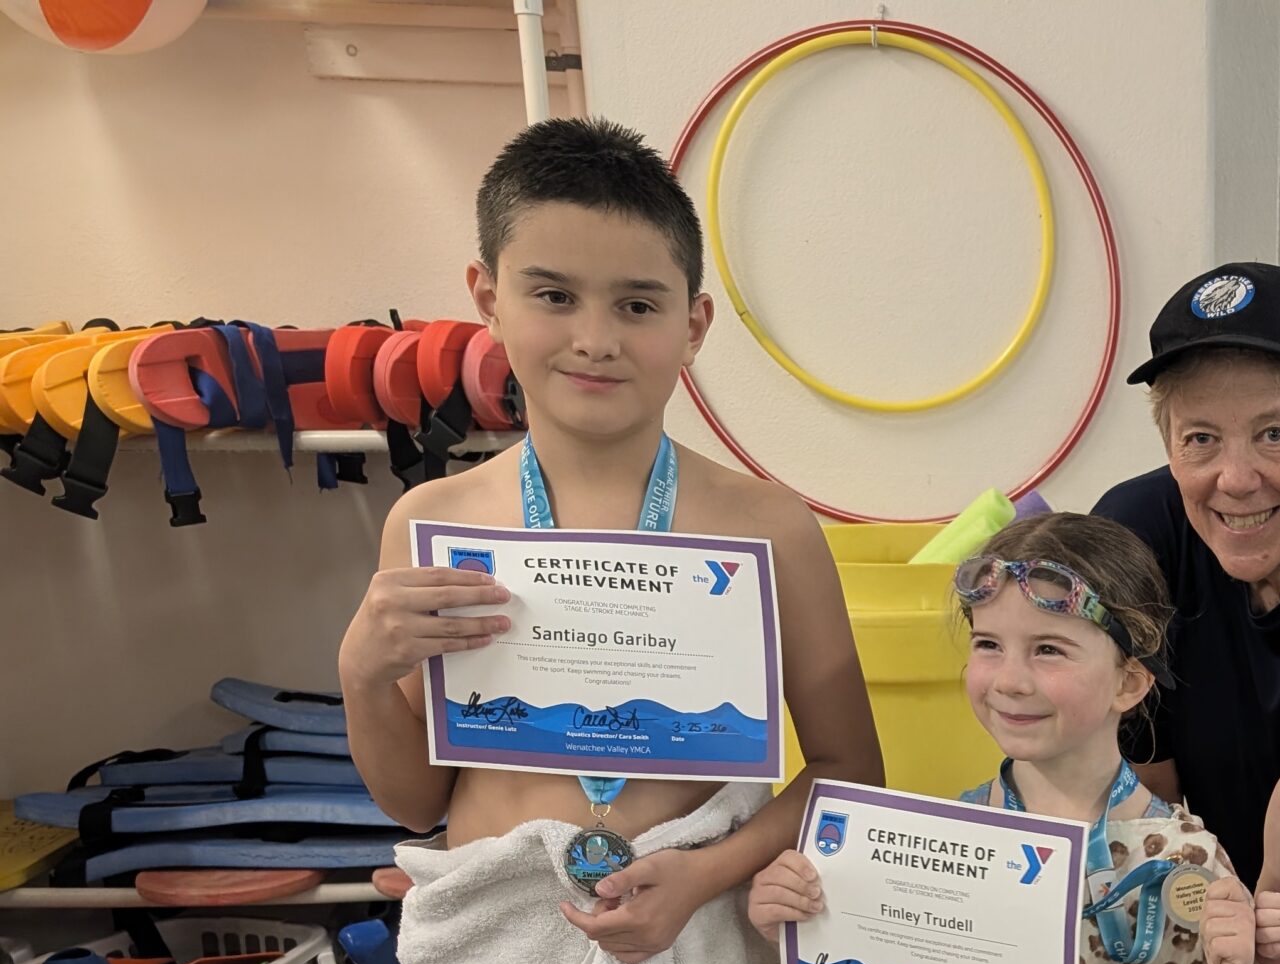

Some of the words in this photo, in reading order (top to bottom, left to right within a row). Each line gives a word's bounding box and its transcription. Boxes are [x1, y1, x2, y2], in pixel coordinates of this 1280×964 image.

[1193, 275, 1254, 300] WENATCHEE
[1207, 309, 1235, 318] WILD
[523, 471, 535, 504] MORE
[529, 505, 541, 528] OUT
[645, 478, 665, 530] FUTURE
[524, 558, 648, 574] CERTIFICATE
[656, 565, 679, 577] OF
[534, 573, 673, 593] ACHIEVEMENT
[693, 575, 709, 584] the
[555, 599, 607, 608] CONGRATULATION
[619, 603, 656, 612] COMPLETING
[564, 605, 583, 613] STAGE
[592, 607, 613, 615] STROKE
[615, 609, 649, 617] MECHANICS
[532, 626, 607, 647] Santiago
[613, 631, 676, 651] Garibay
[530, 655, 556, 664] certificate
[558, 657, 588, 666] recognizes
[590, 658, 601, 666] your
[604, 659, 636, 668] exceptional
[638, 661, 650, 669] skills
[652, 661, 662, 669] and
[664, 662, 696, 671] commitment
[533, 665, 538, 673] to
[540, 666, 548, 674] the
[568, 667, 582, 675] Keep
[583, 668, 610, 676] swimming
[612, 669, 622, 677] and
[624, 670, 645, 678] chasing
[585, 678, 631, 686] Congratulations!
[457, 722, 487, 730] Instructor/
[566, 731, 590, 739] Aquatics
[591, 732, 618, 740] Director/
[566, 742, 605, 752] Wenatchee
[607, 744, 628, 753] Valley
[630, 745, 651, 754] YMCA
[868, 828, 969, 858] CERTIFICATE
[975, 847, 996, 862] OF
[871, 849, 988, 880] ACHIEVEMENT
[1006, 861, 1022, 871] the
[1183, 898, 1198, 906] Level
[881, 904, 921, 925] Finley
[924, 912, 973, 932] Trudell
[1146, 895, 1158, 934] THRIVE
